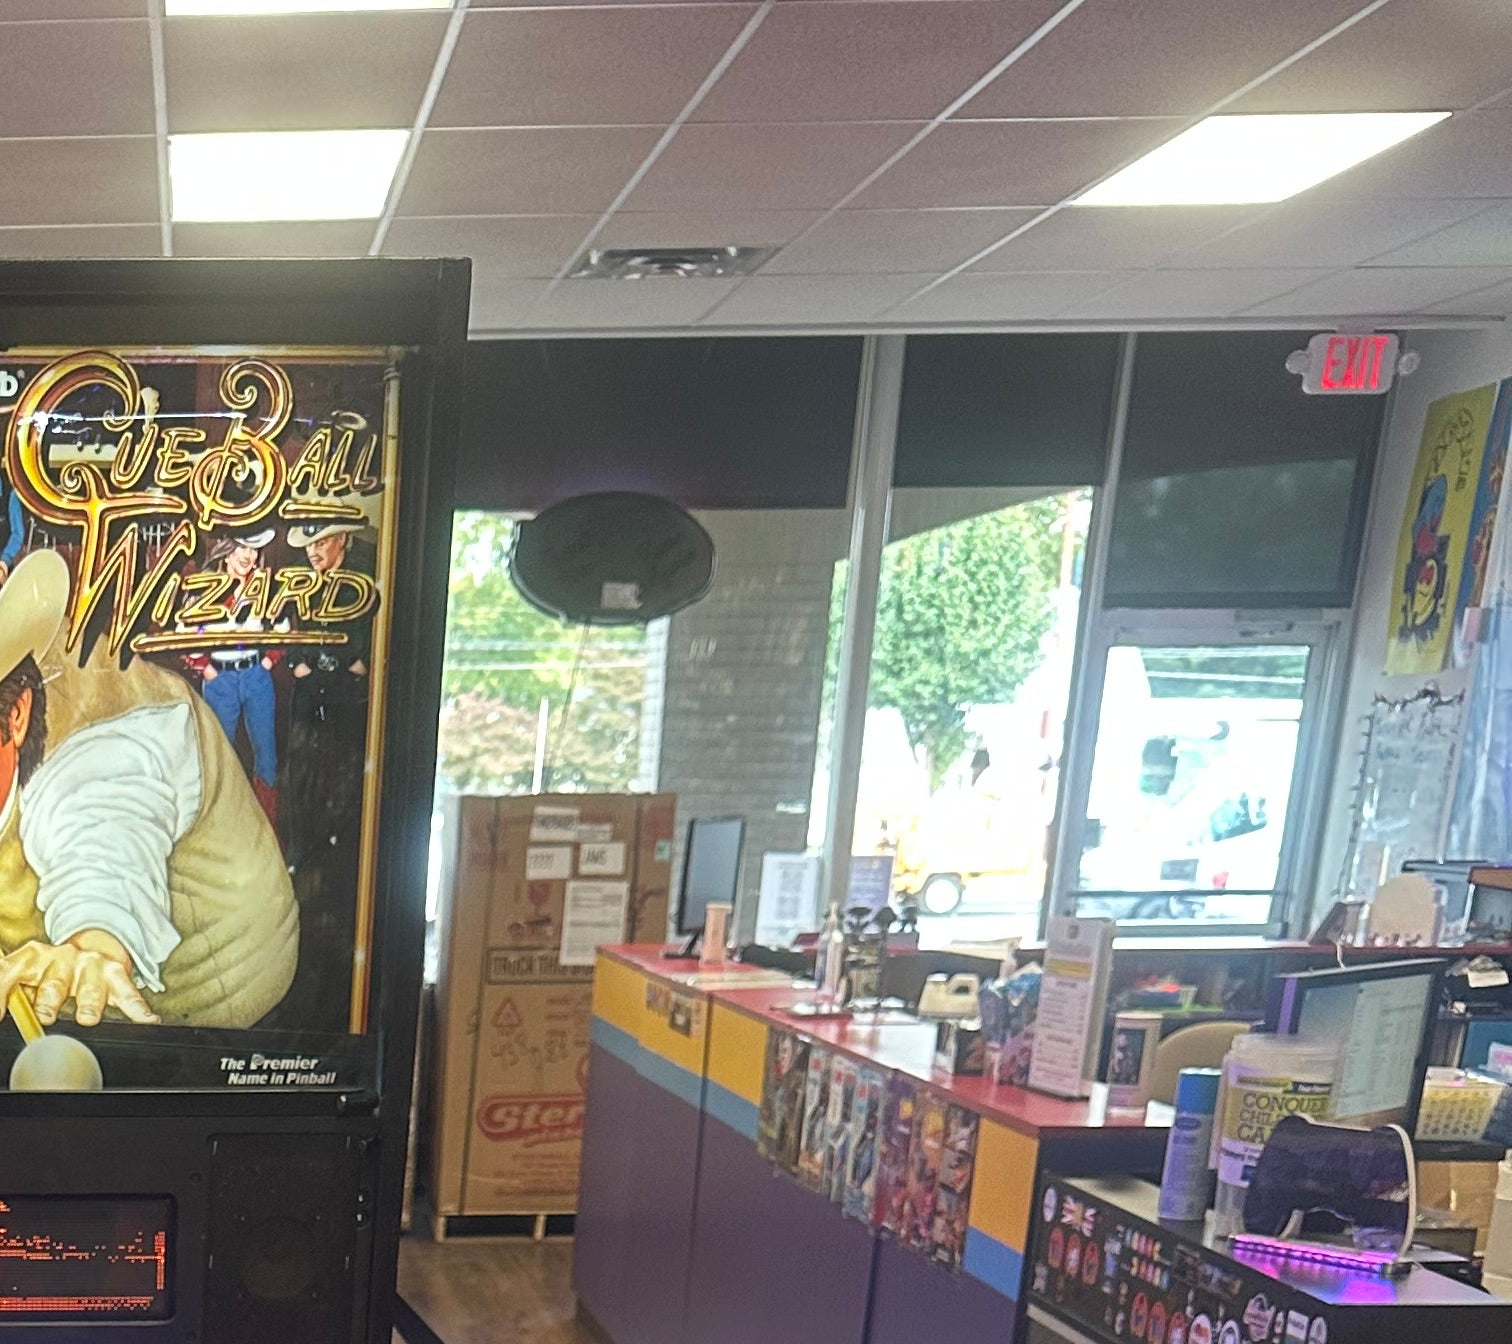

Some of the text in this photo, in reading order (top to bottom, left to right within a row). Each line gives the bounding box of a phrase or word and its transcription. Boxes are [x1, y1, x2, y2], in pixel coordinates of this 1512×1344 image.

[1321, 337, 1389, 390] EXIT
[220, 1053, 318, 1070] The Premier
[228, 1073, 268, 1085] Name
[286, 1072, 336, 1085] Pinball
